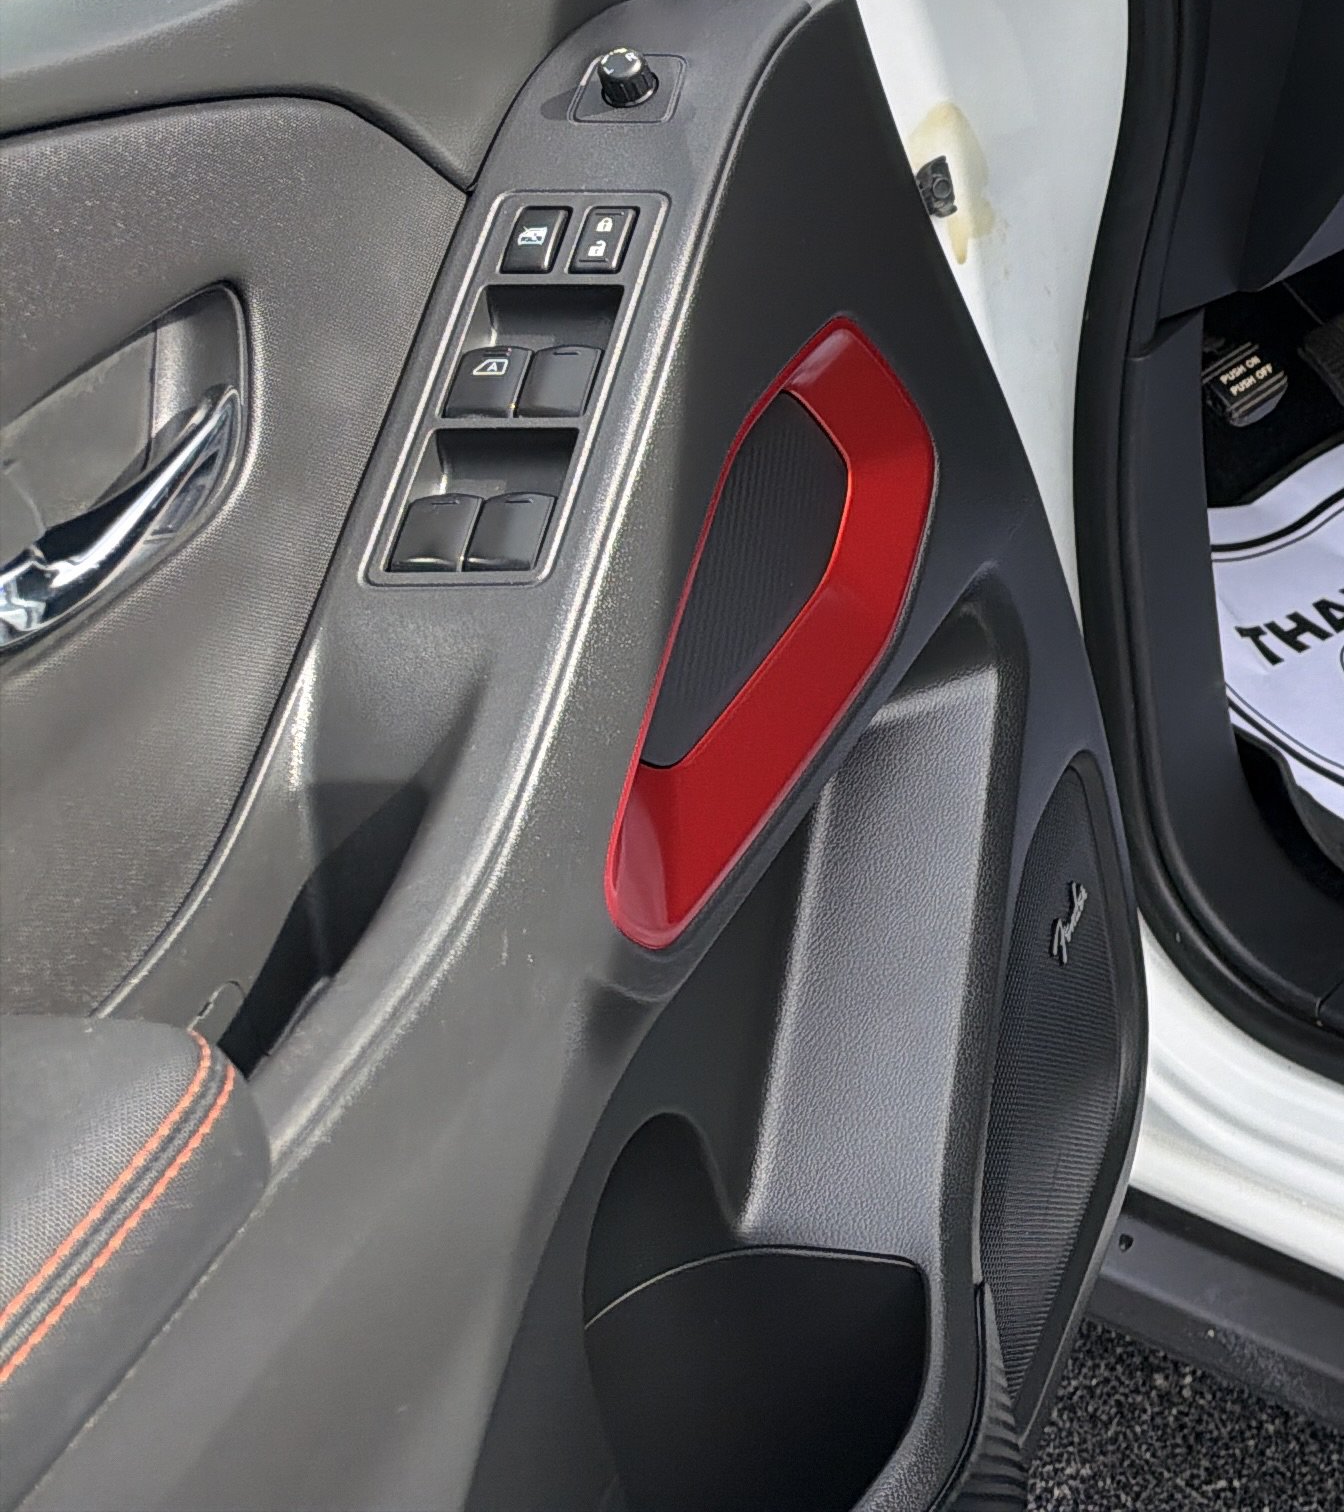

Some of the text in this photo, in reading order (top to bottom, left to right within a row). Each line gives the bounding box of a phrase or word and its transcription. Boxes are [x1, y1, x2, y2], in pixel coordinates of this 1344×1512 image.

[625, 52, 639, 62] R
[603, 66, 614, 75] L
[1220, 356, 1261, 384] PUSH ON
[1230, 364, 1272, 396] PUSH OFF
